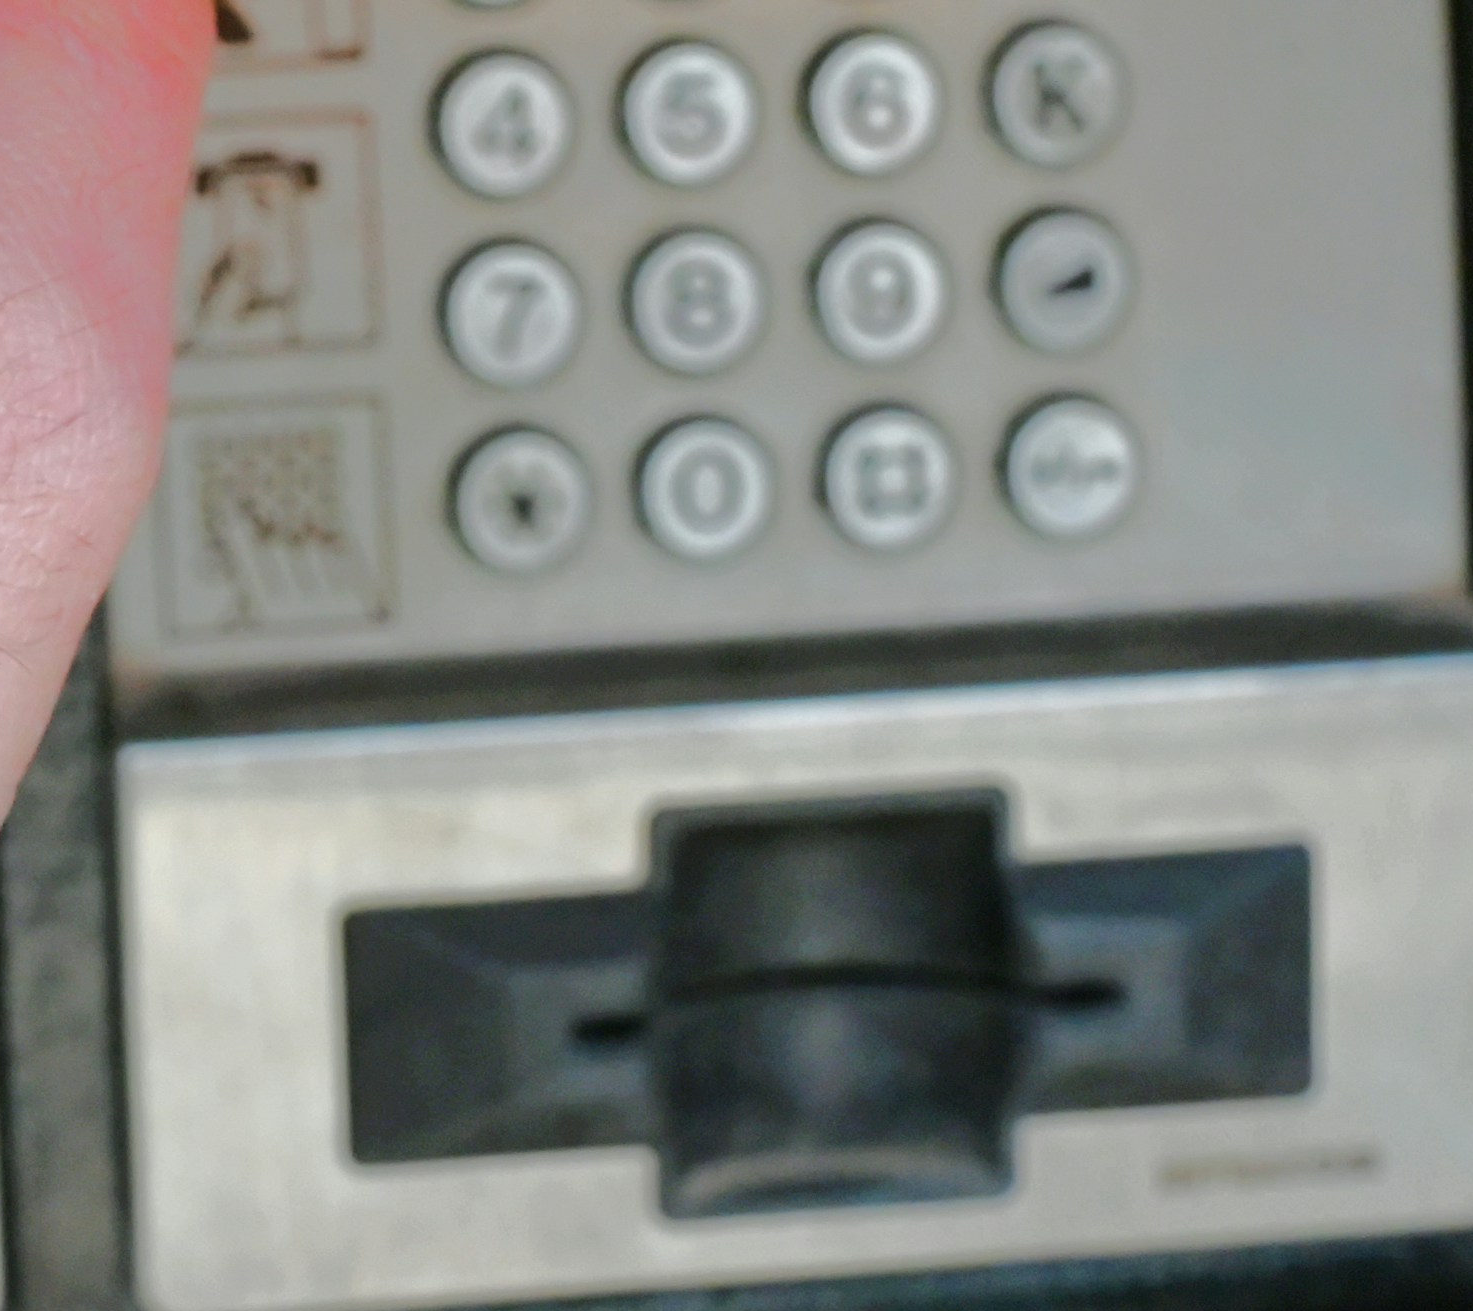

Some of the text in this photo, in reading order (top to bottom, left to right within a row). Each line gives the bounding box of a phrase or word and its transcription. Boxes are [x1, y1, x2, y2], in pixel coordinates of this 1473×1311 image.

[470, 86, 536, 163] 4
[654, 71, 725, 161] 5
[841, 56, 918, 154] 6
[482, 245, 916, 357] 7 8 9
[672, 441, 744, 534] 0
